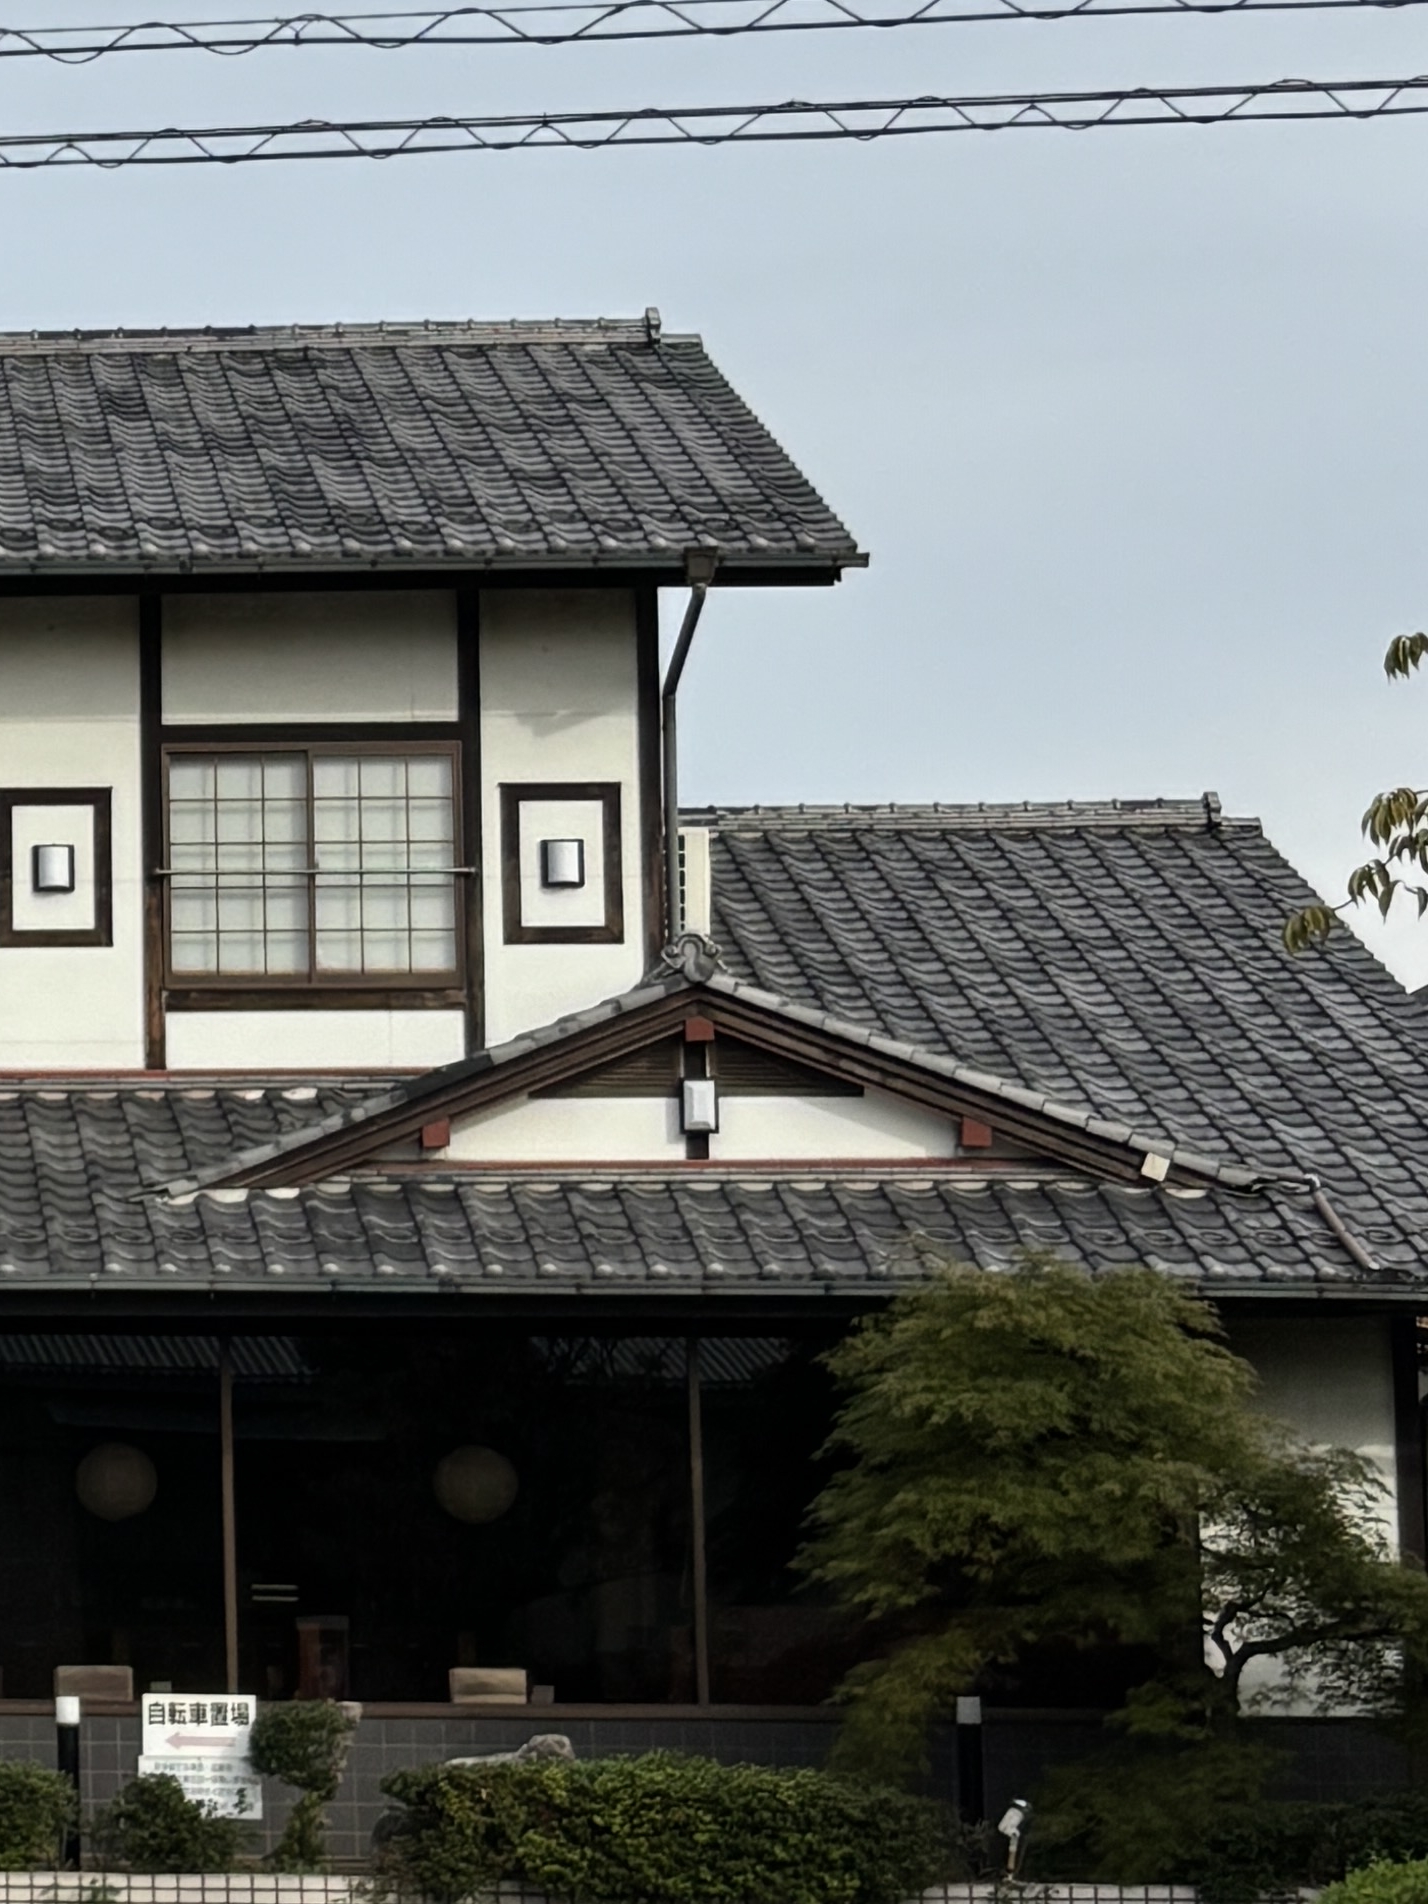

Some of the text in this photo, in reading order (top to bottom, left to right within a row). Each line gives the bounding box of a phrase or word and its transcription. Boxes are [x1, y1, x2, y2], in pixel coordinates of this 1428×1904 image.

[148, 1701, 250, 1727] 自転車置場
